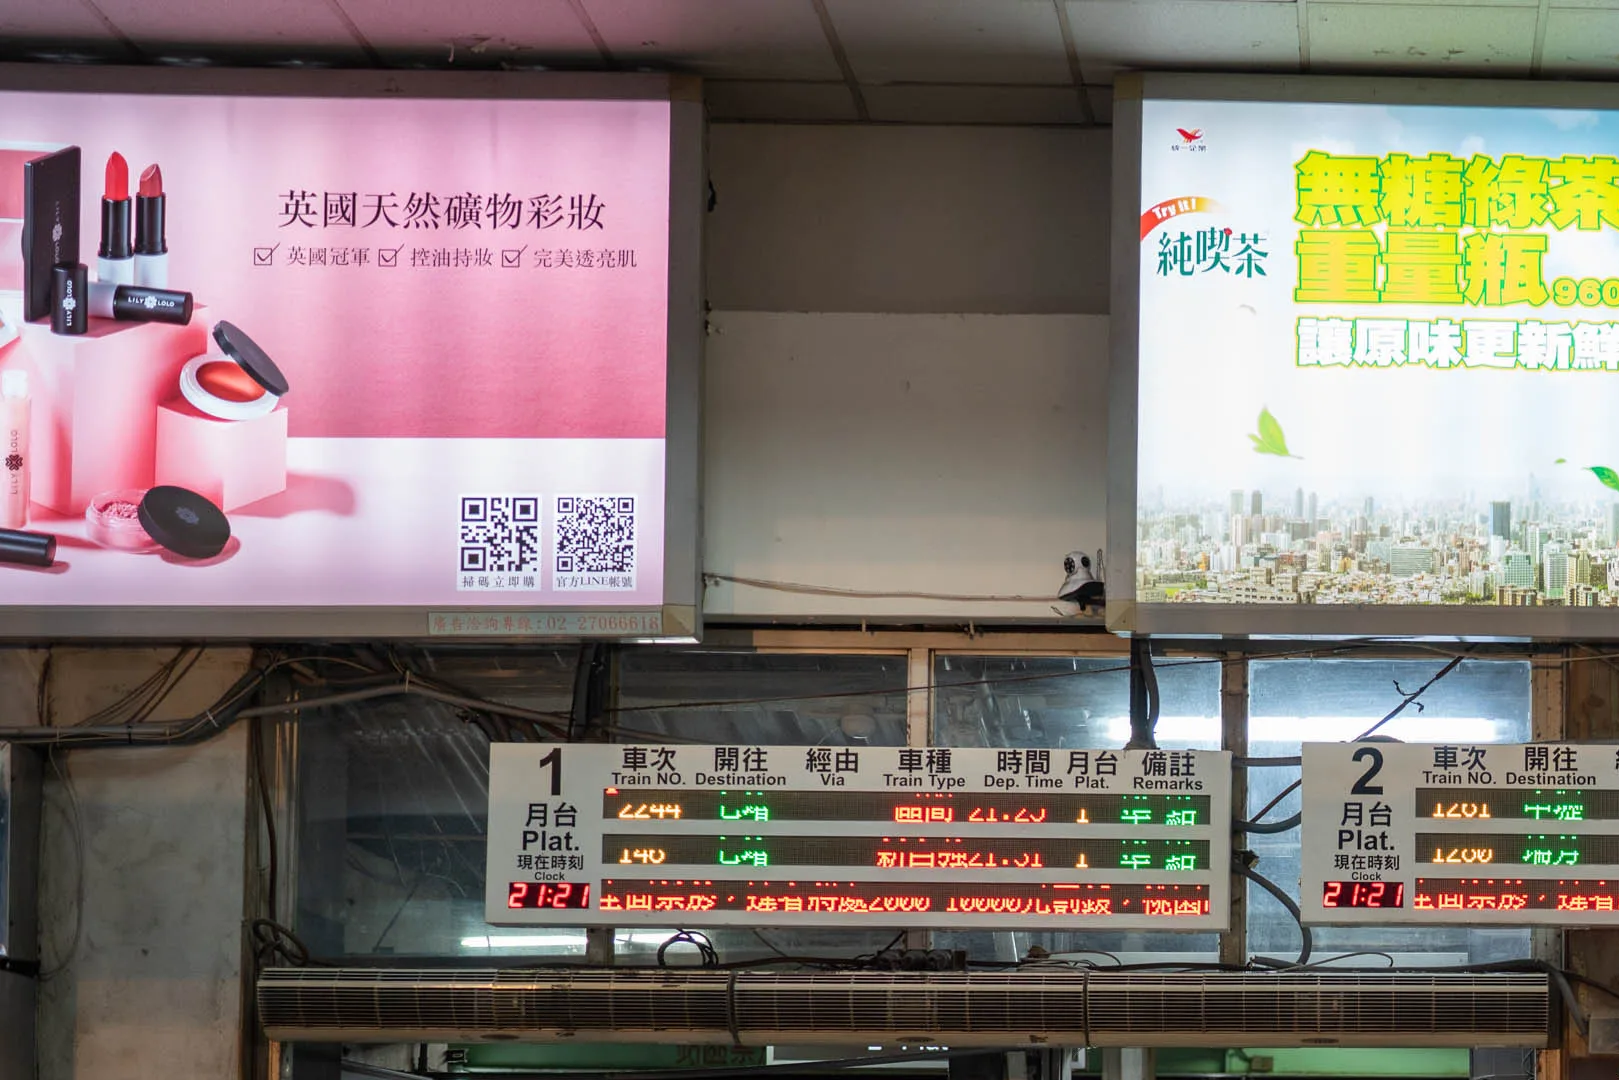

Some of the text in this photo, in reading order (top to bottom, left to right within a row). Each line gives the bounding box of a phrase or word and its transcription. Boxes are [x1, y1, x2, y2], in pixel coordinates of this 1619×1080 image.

[278, 189, 606, 231] 英國天然礦物彩妝
[287, 245, 637, 269] 英國冠軍 控油持妝 完美透亮肌
[1156, 227, 1269, 278] 純喫茶
[1293, 230, 1551, 308] 重量瓶
[461, 575, 535, 588] 掃碼立即購
[556, 575, 633, 588] 官方LINE帳號
[622, 746, 1196, 777] 車次 開往 經由 車種 時間 月台 備註
[1433, 746, 1487, 771] 車次
[1524, 747, 1577, 772] 開往
[538, 747, 562, 796] 1
[612, 772, 1203, 790] Train NO. Destination Via Train Type Dep. Time Plat. Remarks
[1350, 747, 1384, 796] 2
[1422, 771, 1462, 785] Train
[1467, 772, 1497, 785] NO.
[1506, 772, 1597, 785] Destination
[526, 802, 578, 828] 月台
[1341, 802, 1392, 827] 月台
[522, 831, 580, 851] Plat.
[1338, 830, 1395, 851] Plat.
[517, 855, 584, 870] 現在時刻
[1334, 855, 1400, 870] 現在時刻
[534, 871, 565, 881] Clock
[1351, 871, 1382, 881] Clock
[508, 883, 590, 908] 21:21
[1323, 882, 1403, 908] 21:21
